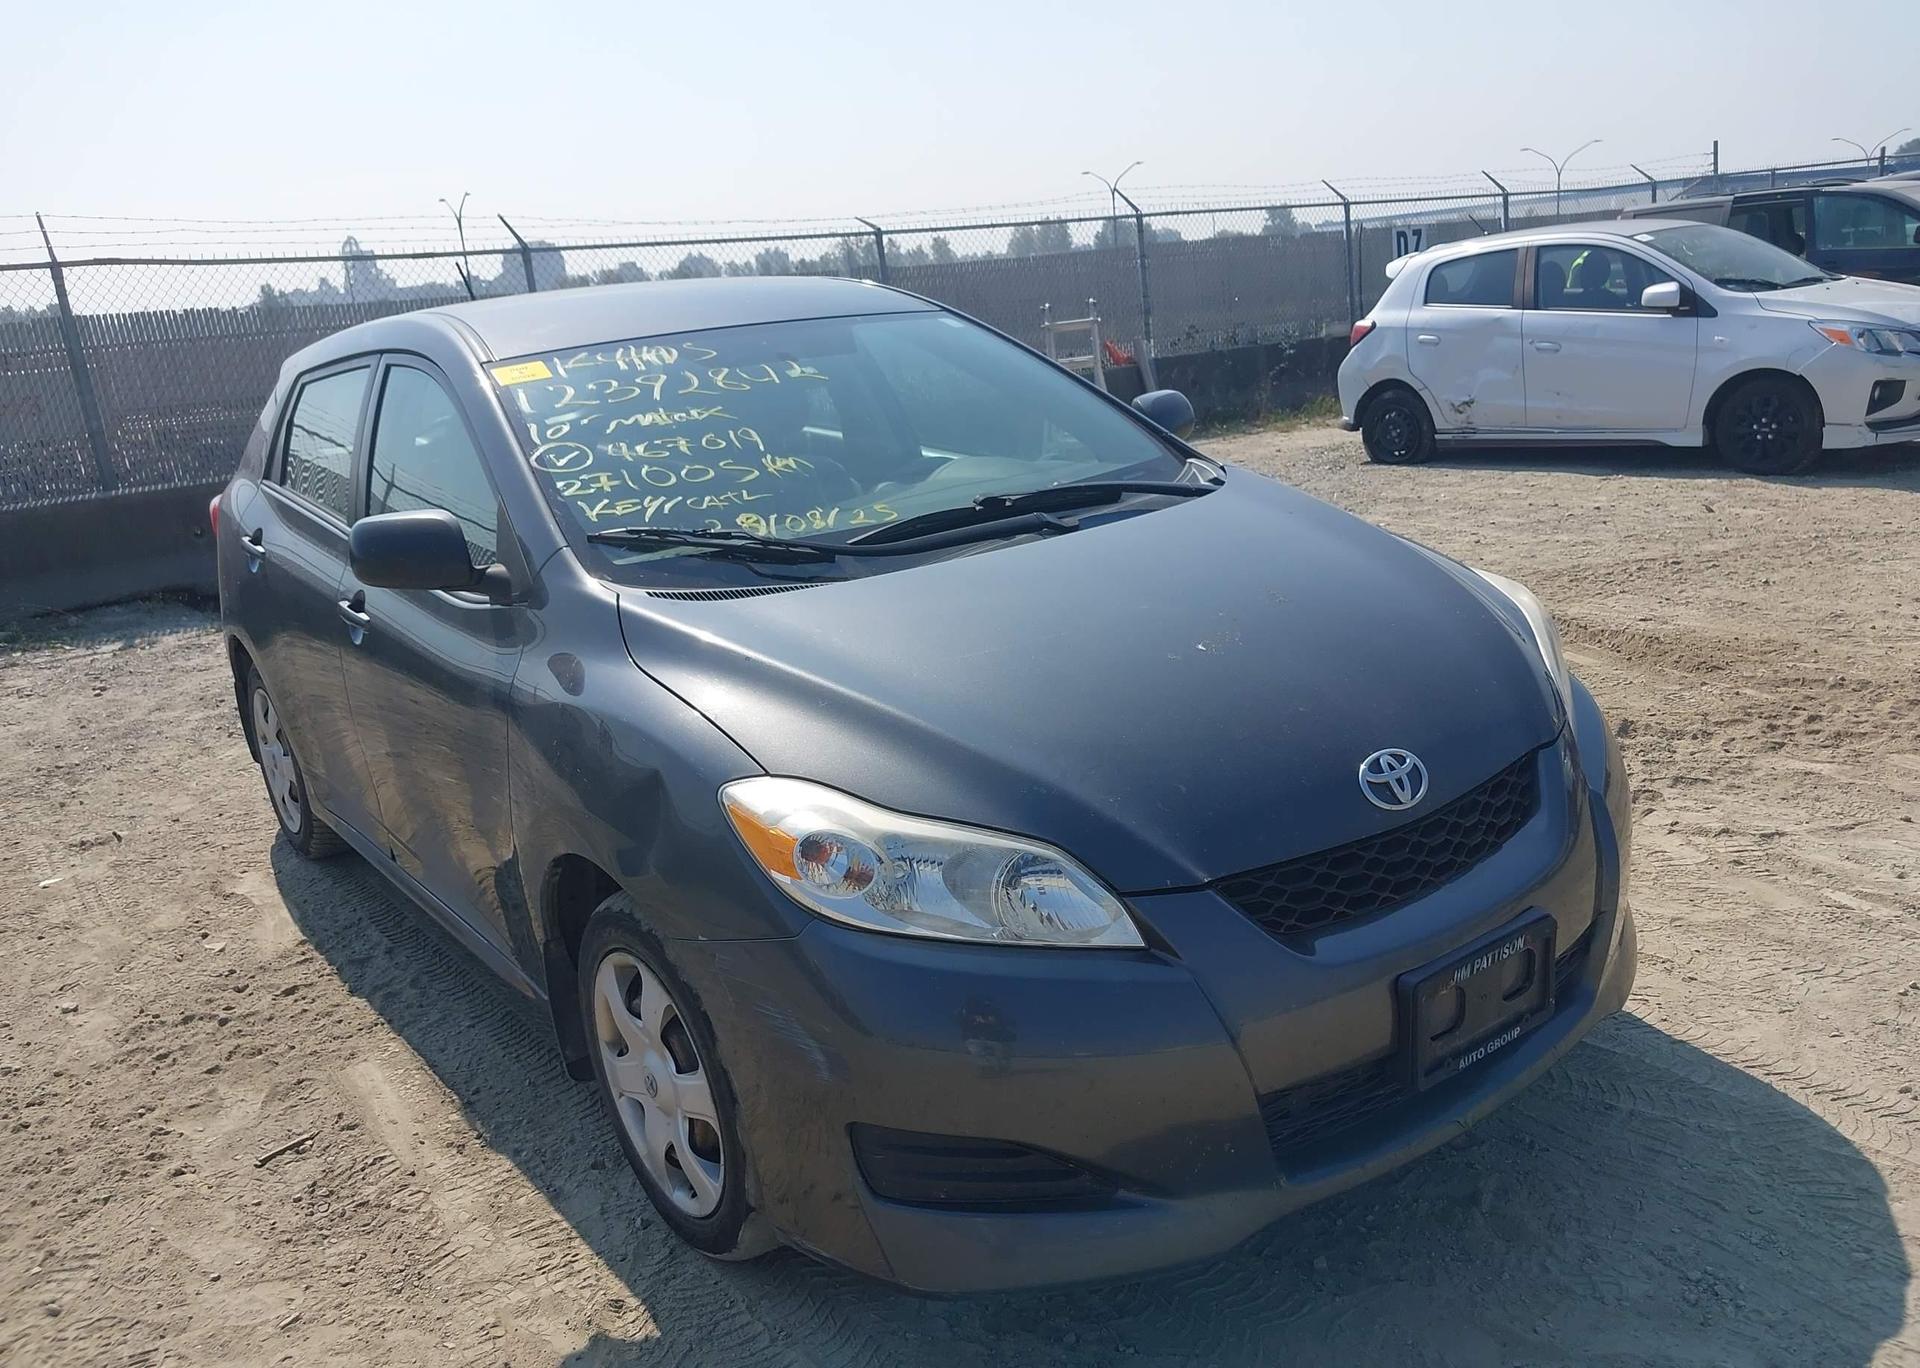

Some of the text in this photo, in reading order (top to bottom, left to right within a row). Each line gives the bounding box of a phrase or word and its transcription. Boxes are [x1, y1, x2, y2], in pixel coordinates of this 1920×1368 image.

[1396, 229, 1423, 258] D7
[1450, 934, 1526, 985] JIM PATTISON
[1459, 1026, 1521, 1070] AUTO GROUP
